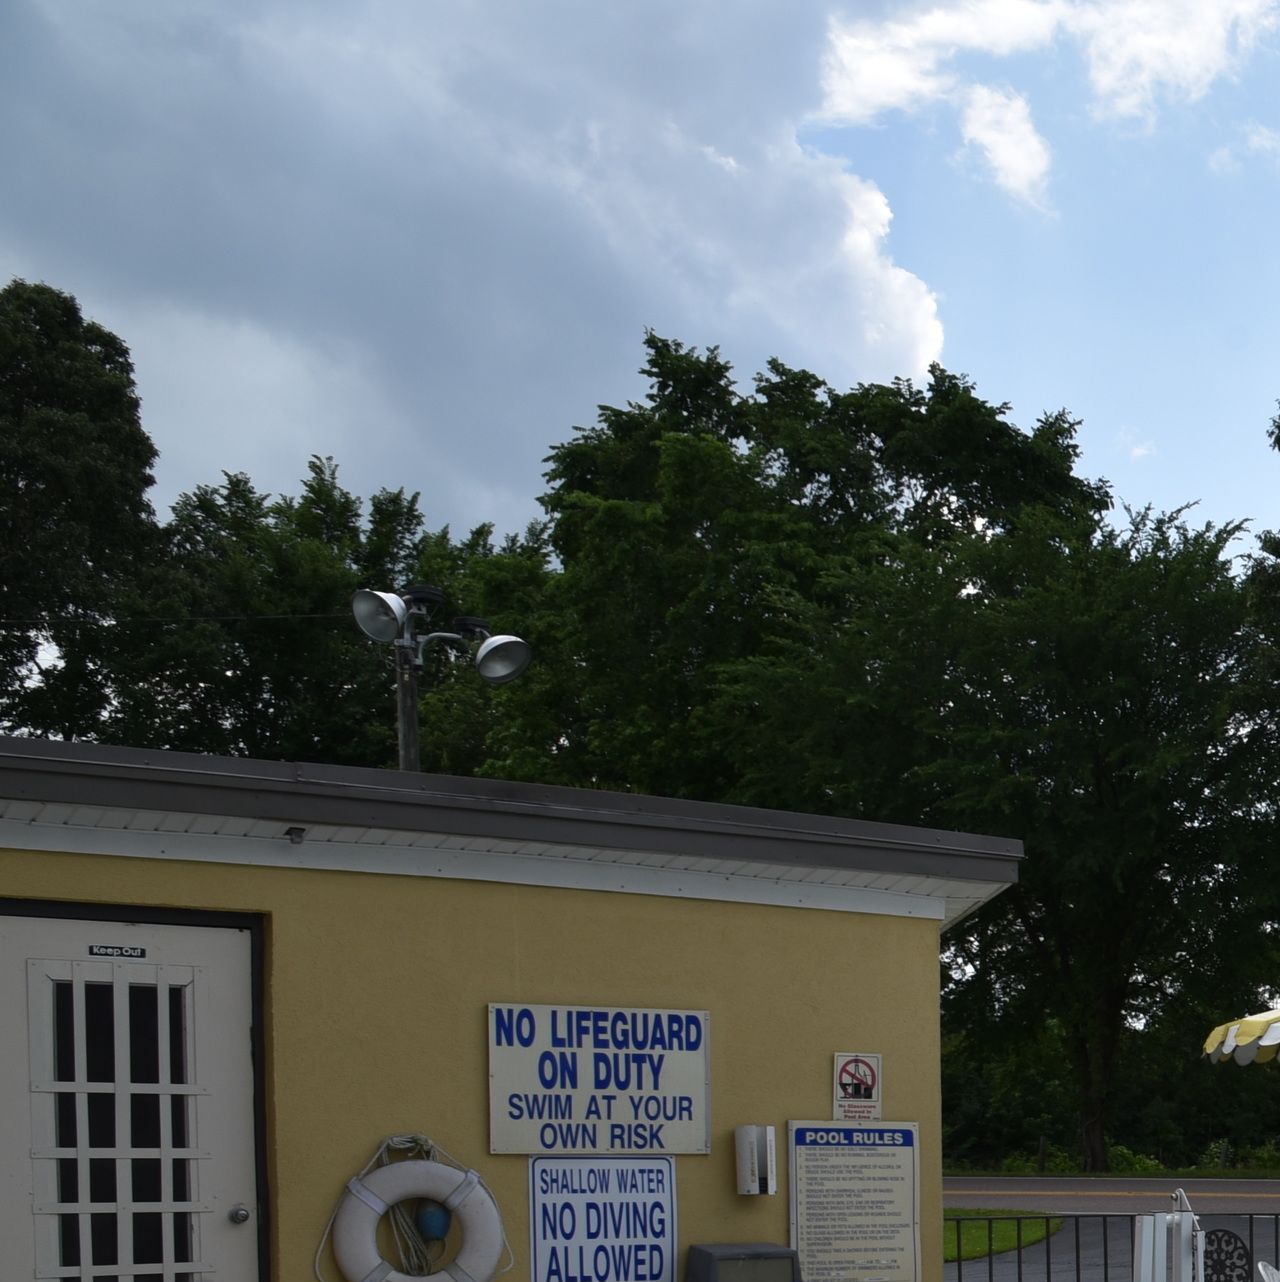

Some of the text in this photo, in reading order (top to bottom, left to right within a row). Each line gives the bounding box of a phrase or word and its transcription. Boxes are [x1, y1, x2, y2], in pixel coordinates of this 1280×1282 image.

[93, 946, 141, 956] Keep Out
[494, 1008, 703, 1051] NO LIFEGUARD
[538, 1051, 665, 1090] ON DUTY
[508, 1094, 693, 1121] SWIM AT YOUR
[540, 1123, 665, 1149] OWN RISK
[806, 1132, 904, 1145] POOL RULES
[540, 1168, 665, 1194] SHALLOW WATER
[542, 1201, 665, 1240] NO DIVING
